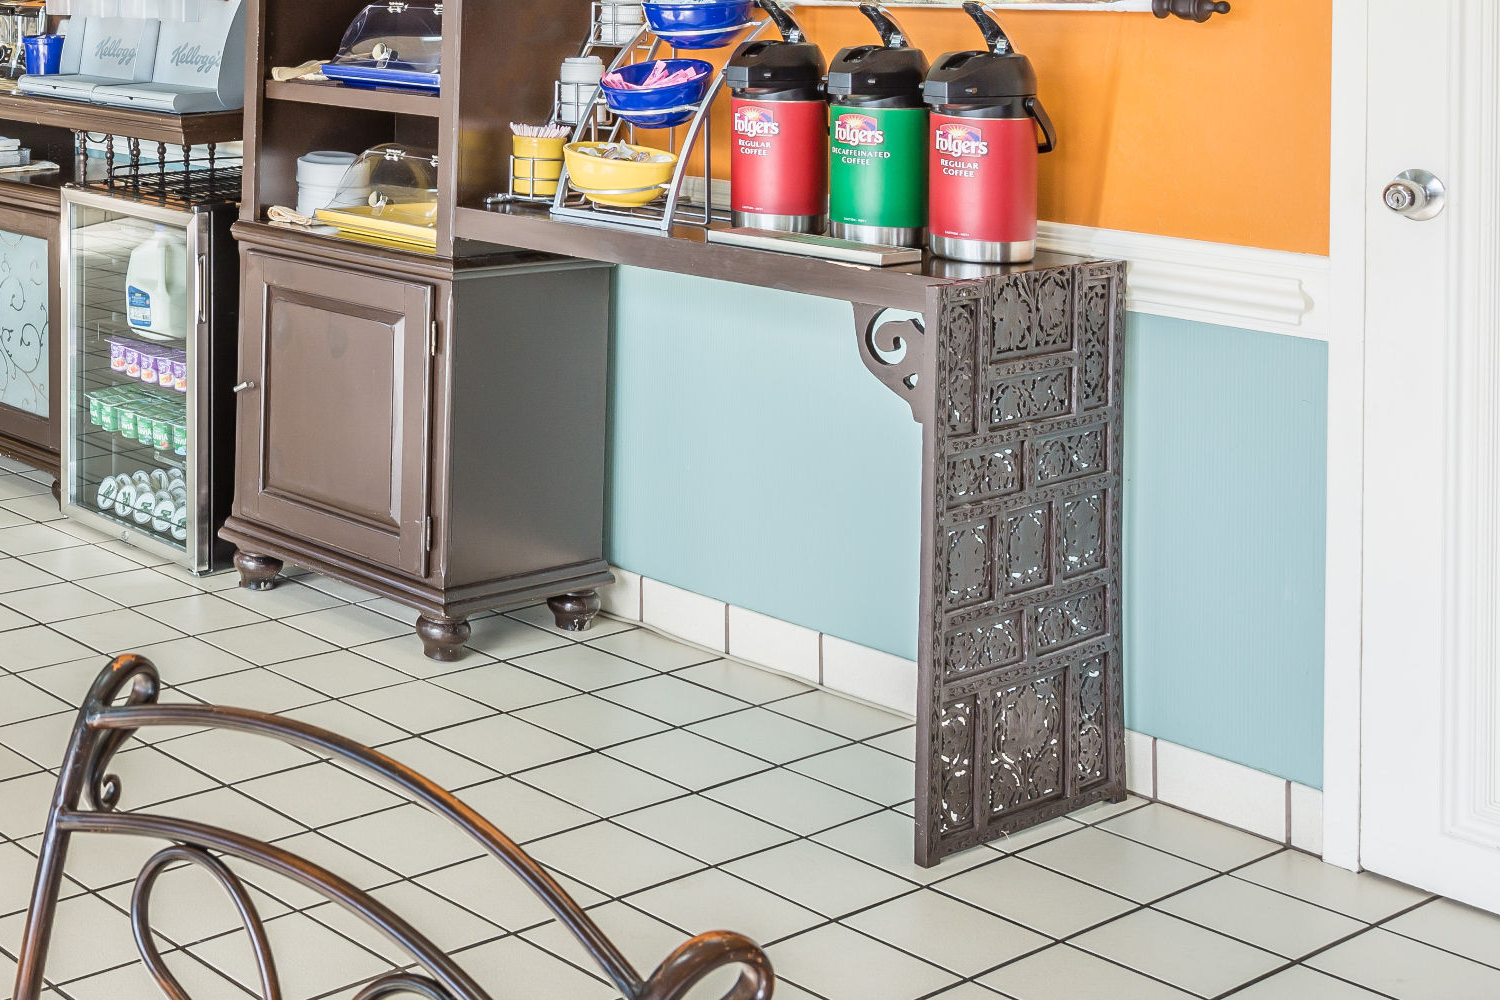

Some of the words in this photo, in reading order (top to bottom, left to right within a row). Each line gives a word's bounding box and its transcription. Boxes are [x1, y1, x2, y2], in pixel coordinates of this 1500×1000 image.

[734, 113, 780, 137] Folgers
[834, 120, 884, 146] Folgers
[738, 138, 771, 149] REGULAR
[935, 130, 988, 157] Folgers
[740, 147, 768, 156] COFFEE
[832, 146, 891, 158] DECAFFEINATED
[841, 156, 871, 166] COFFEE
[940, 158, 979, 170] REGULAR
[942, 167, 975, 178] COFFEE
